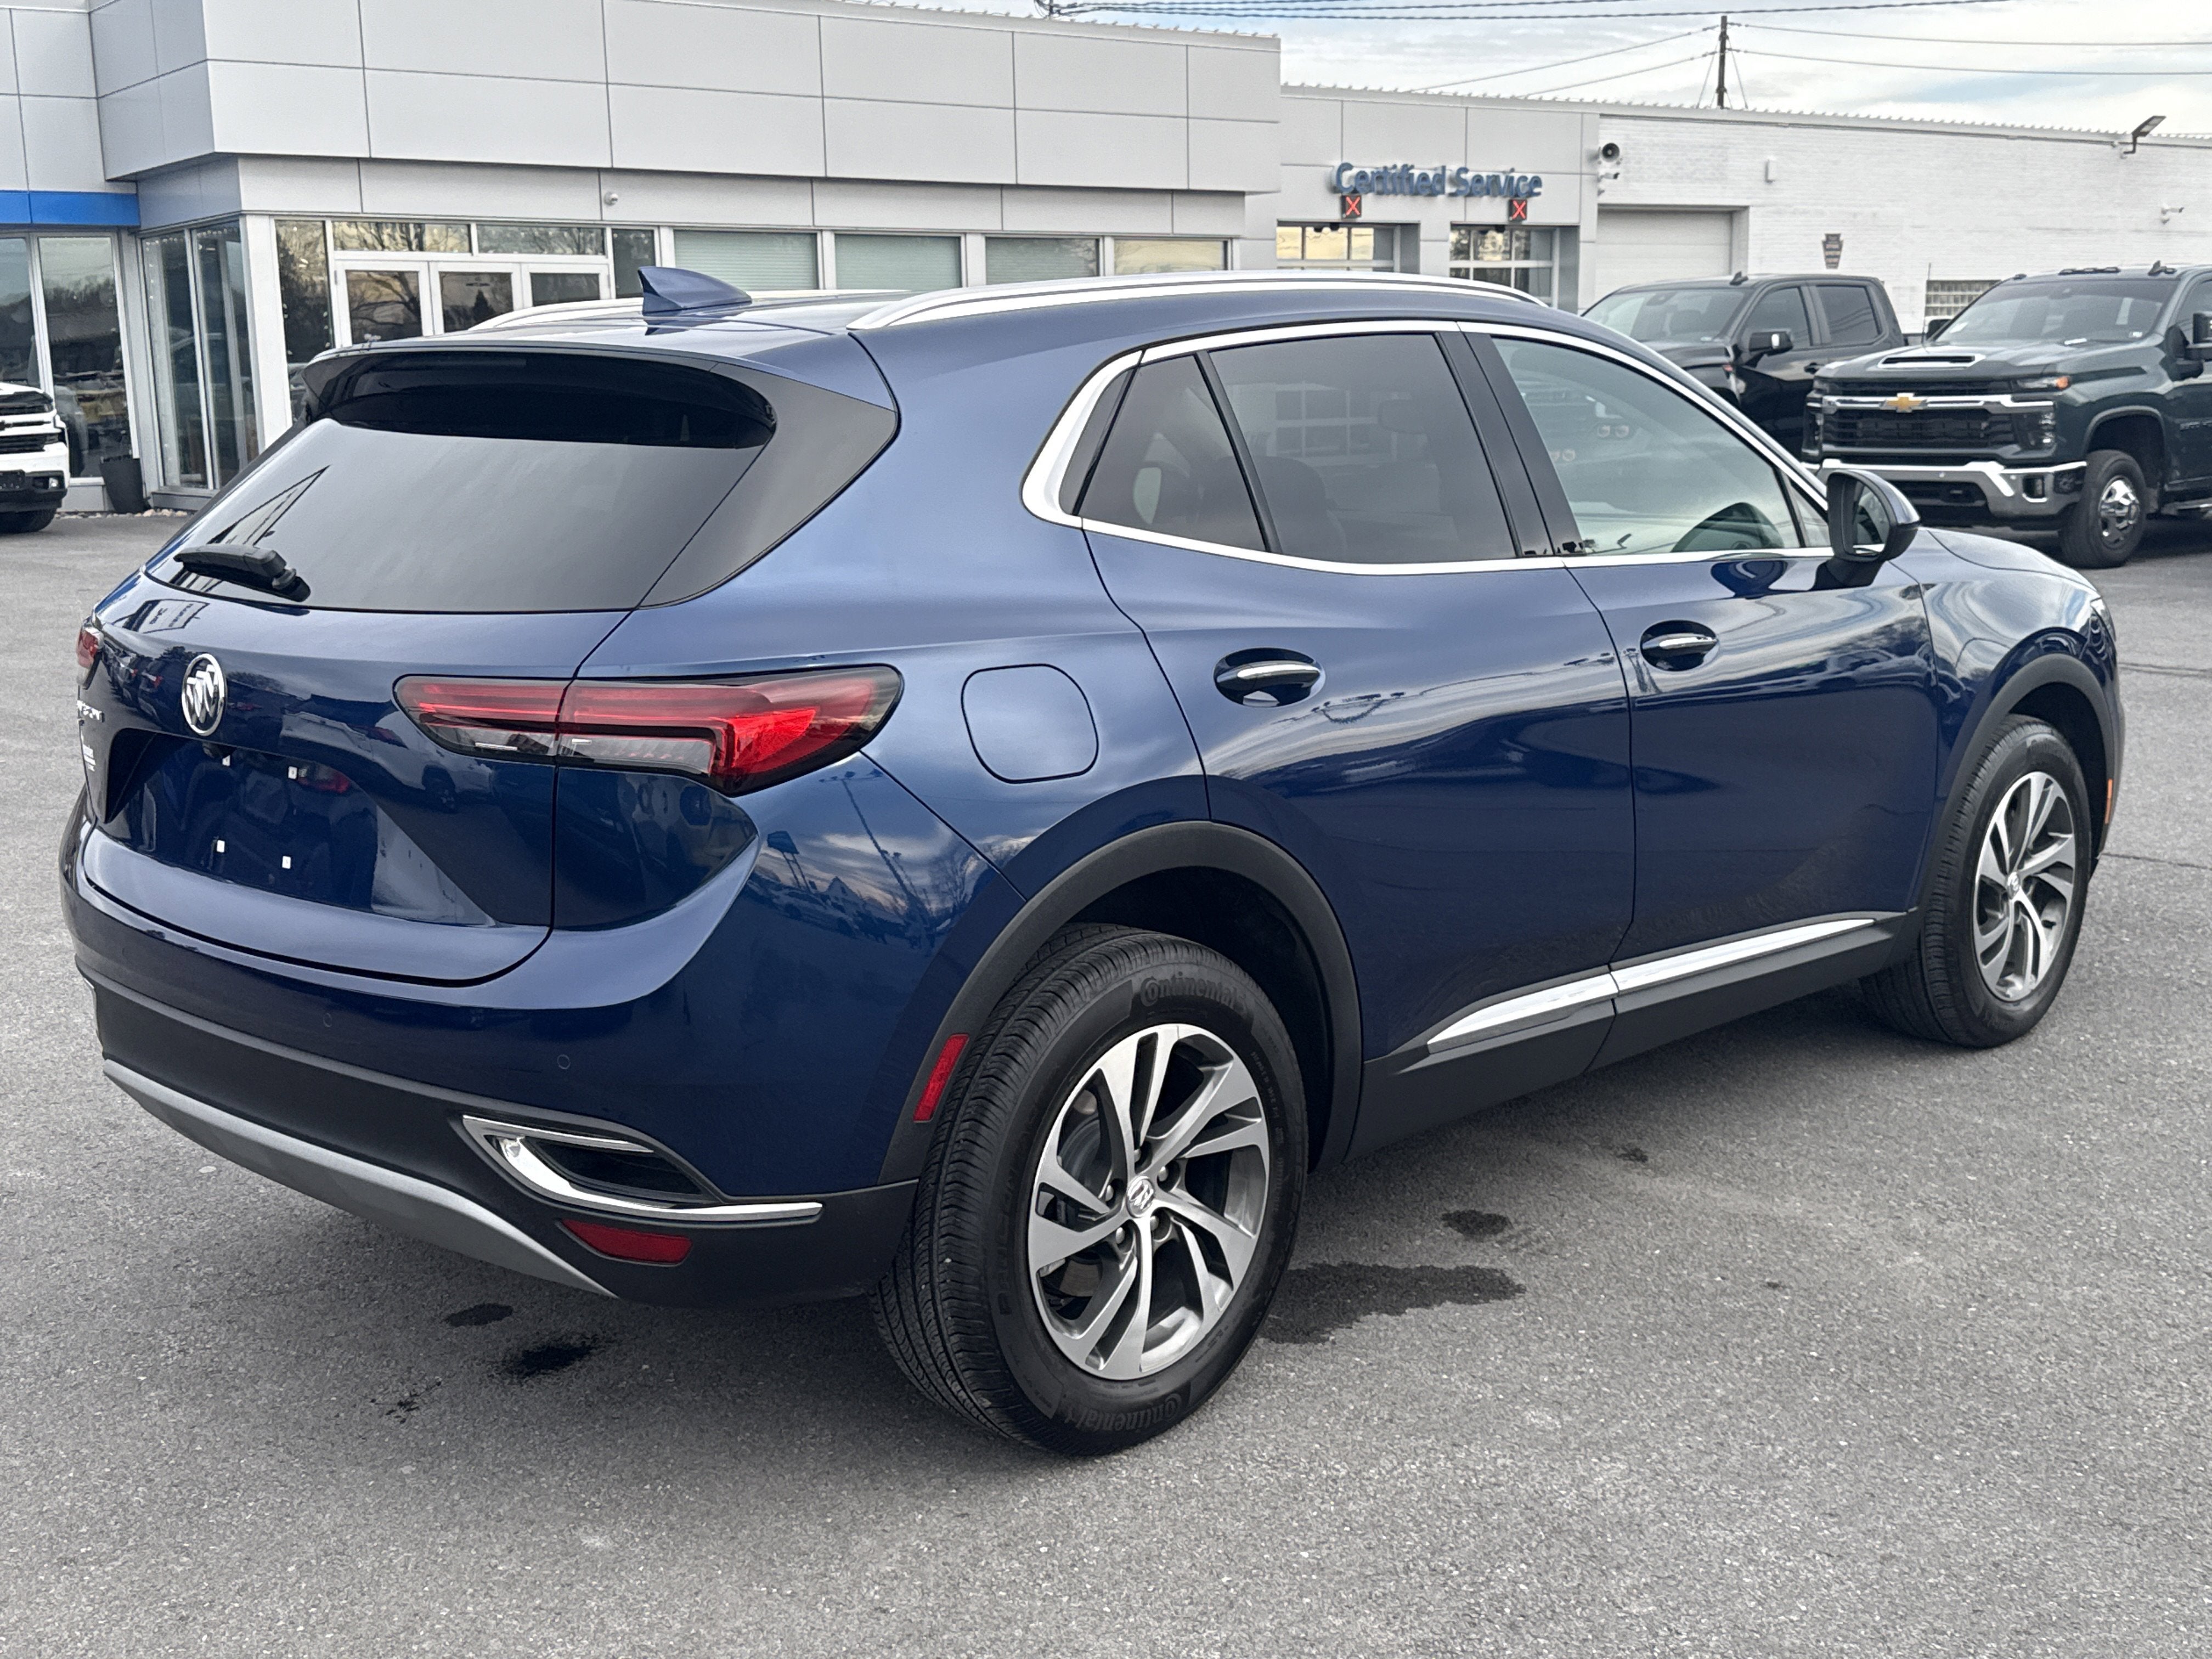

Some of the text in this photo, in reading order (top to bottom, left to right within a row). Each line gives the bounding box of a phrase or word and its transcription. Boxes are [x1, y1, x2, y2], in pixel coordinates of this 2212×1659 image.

[1336, 162, 1543, 198] Certified Service
[1140, 972, 1240, 1008] Continental
[1075, 1392, 1183, 1432] Continental
